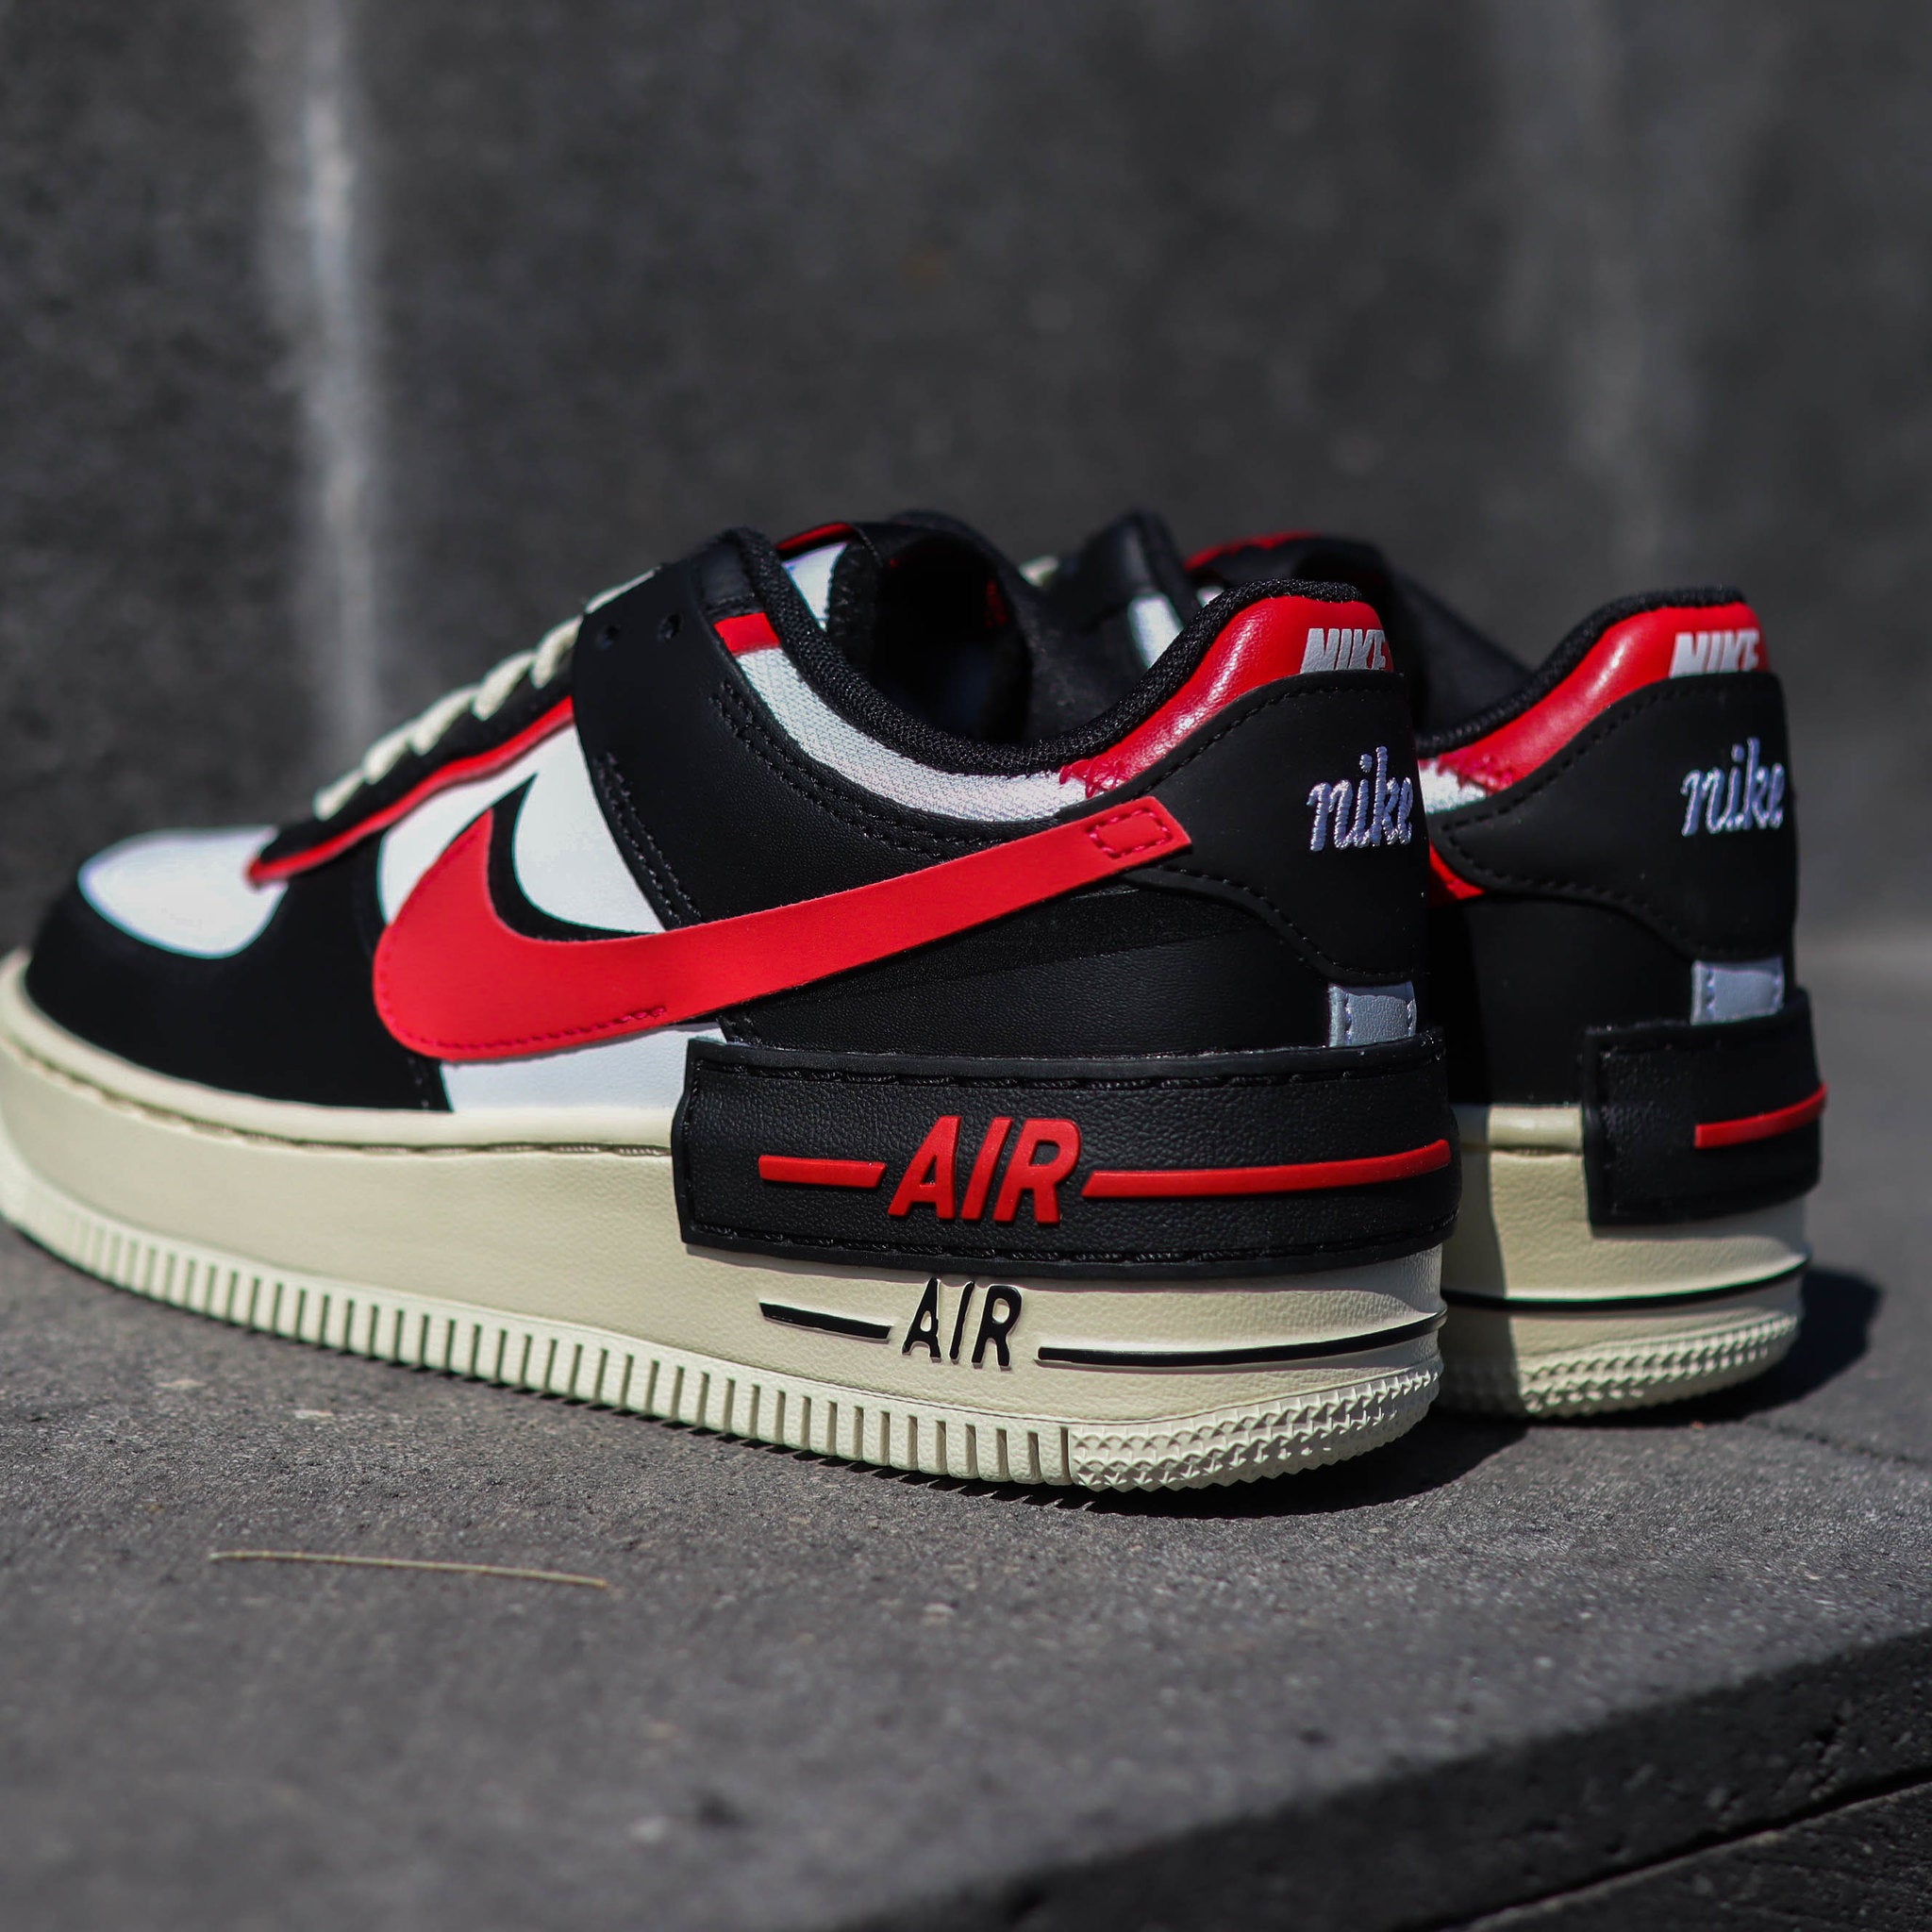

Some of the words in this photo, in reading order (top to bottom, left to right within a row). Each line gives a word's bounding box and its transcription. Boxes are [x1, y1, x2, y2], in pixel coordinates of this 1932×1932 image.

[1300, 627, 1386, 674] NIKE
[1669, 627, 1759, 678] NIKE
[1307, 746, 1413, 851] nike
[1680, 737, 1785, 837] nike
[888, 1115, 1081, 1224] AIR
[902, 1277, 1022, 1368] AIR
